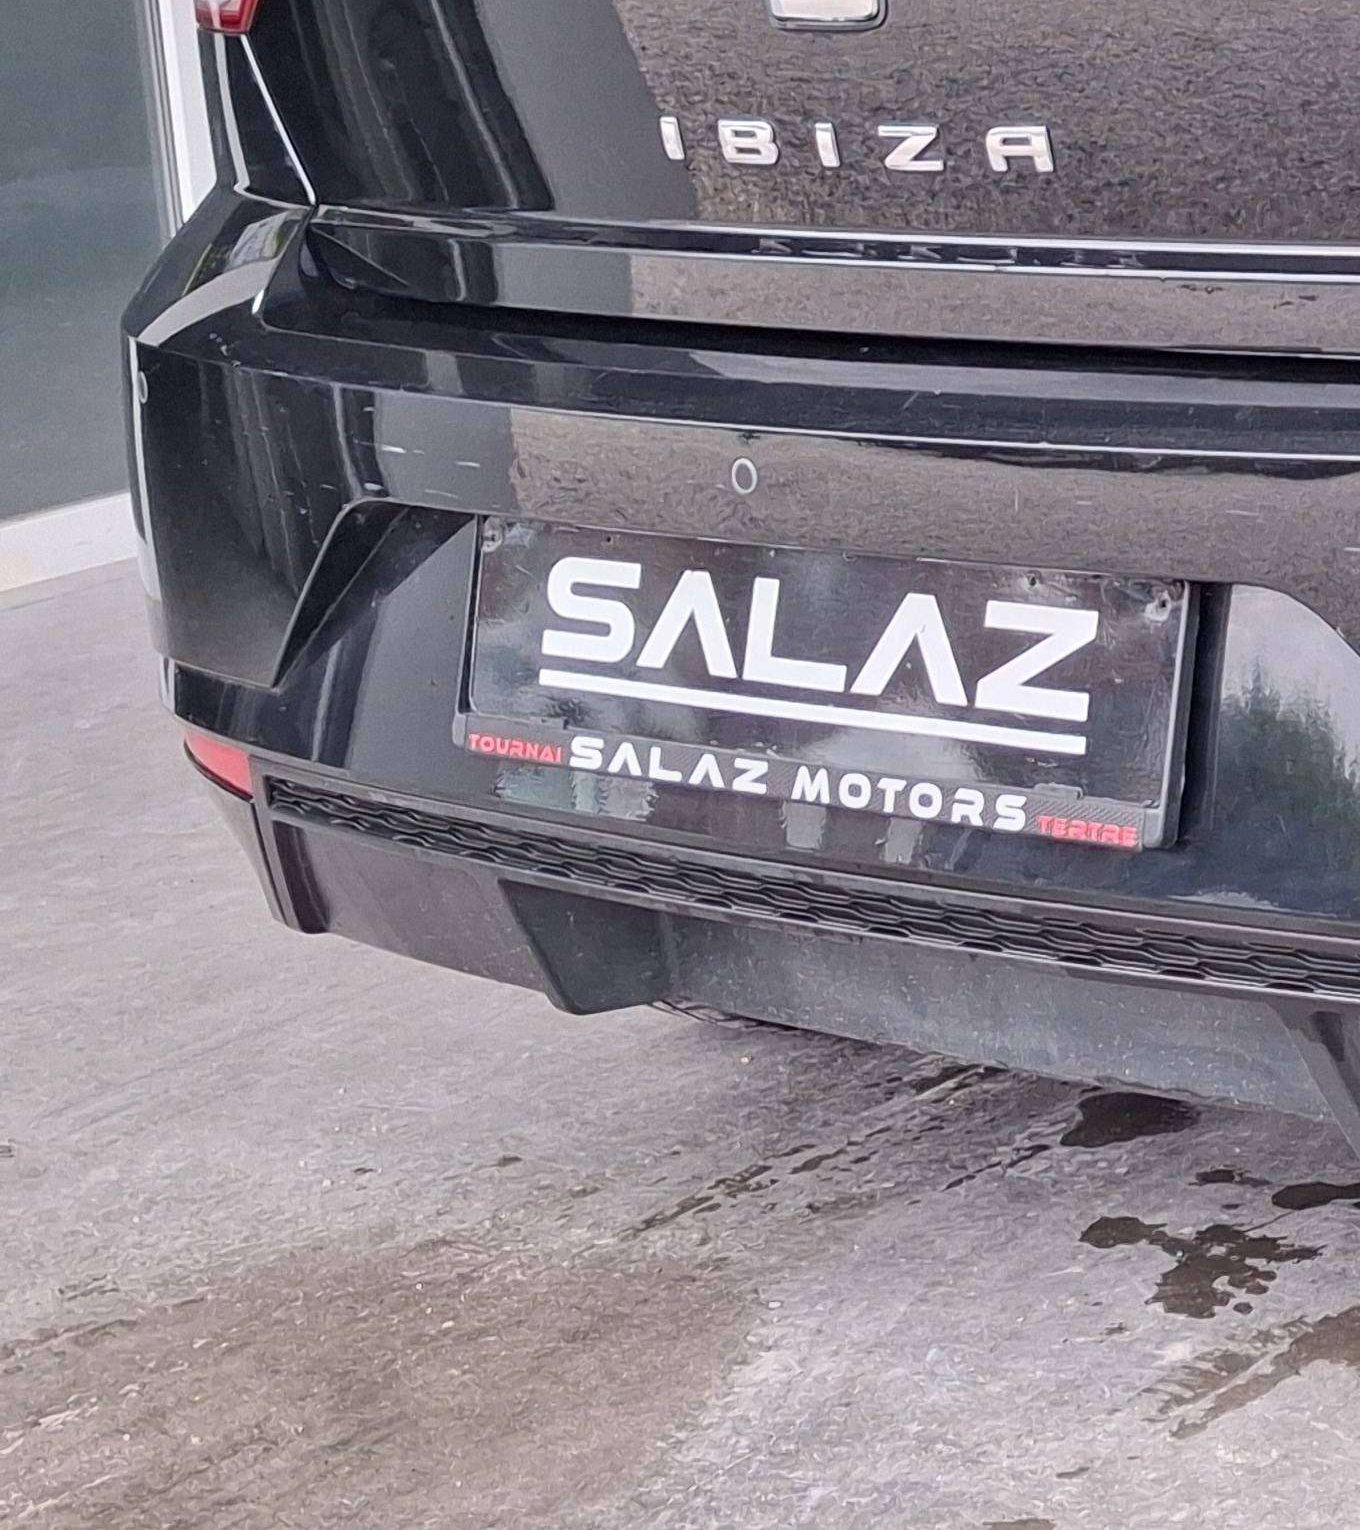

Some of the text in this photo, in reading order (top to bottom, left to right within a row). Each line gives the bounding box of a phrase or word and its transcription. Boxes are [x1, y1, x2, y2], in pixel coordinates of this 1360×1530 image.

[660, 116, 1054, 172] IBIZA
[542, 556, 1099, 722] SALAZ
[469, 734, 1138, 848] TOURNAI SALAZ MOTORS TERTRE
